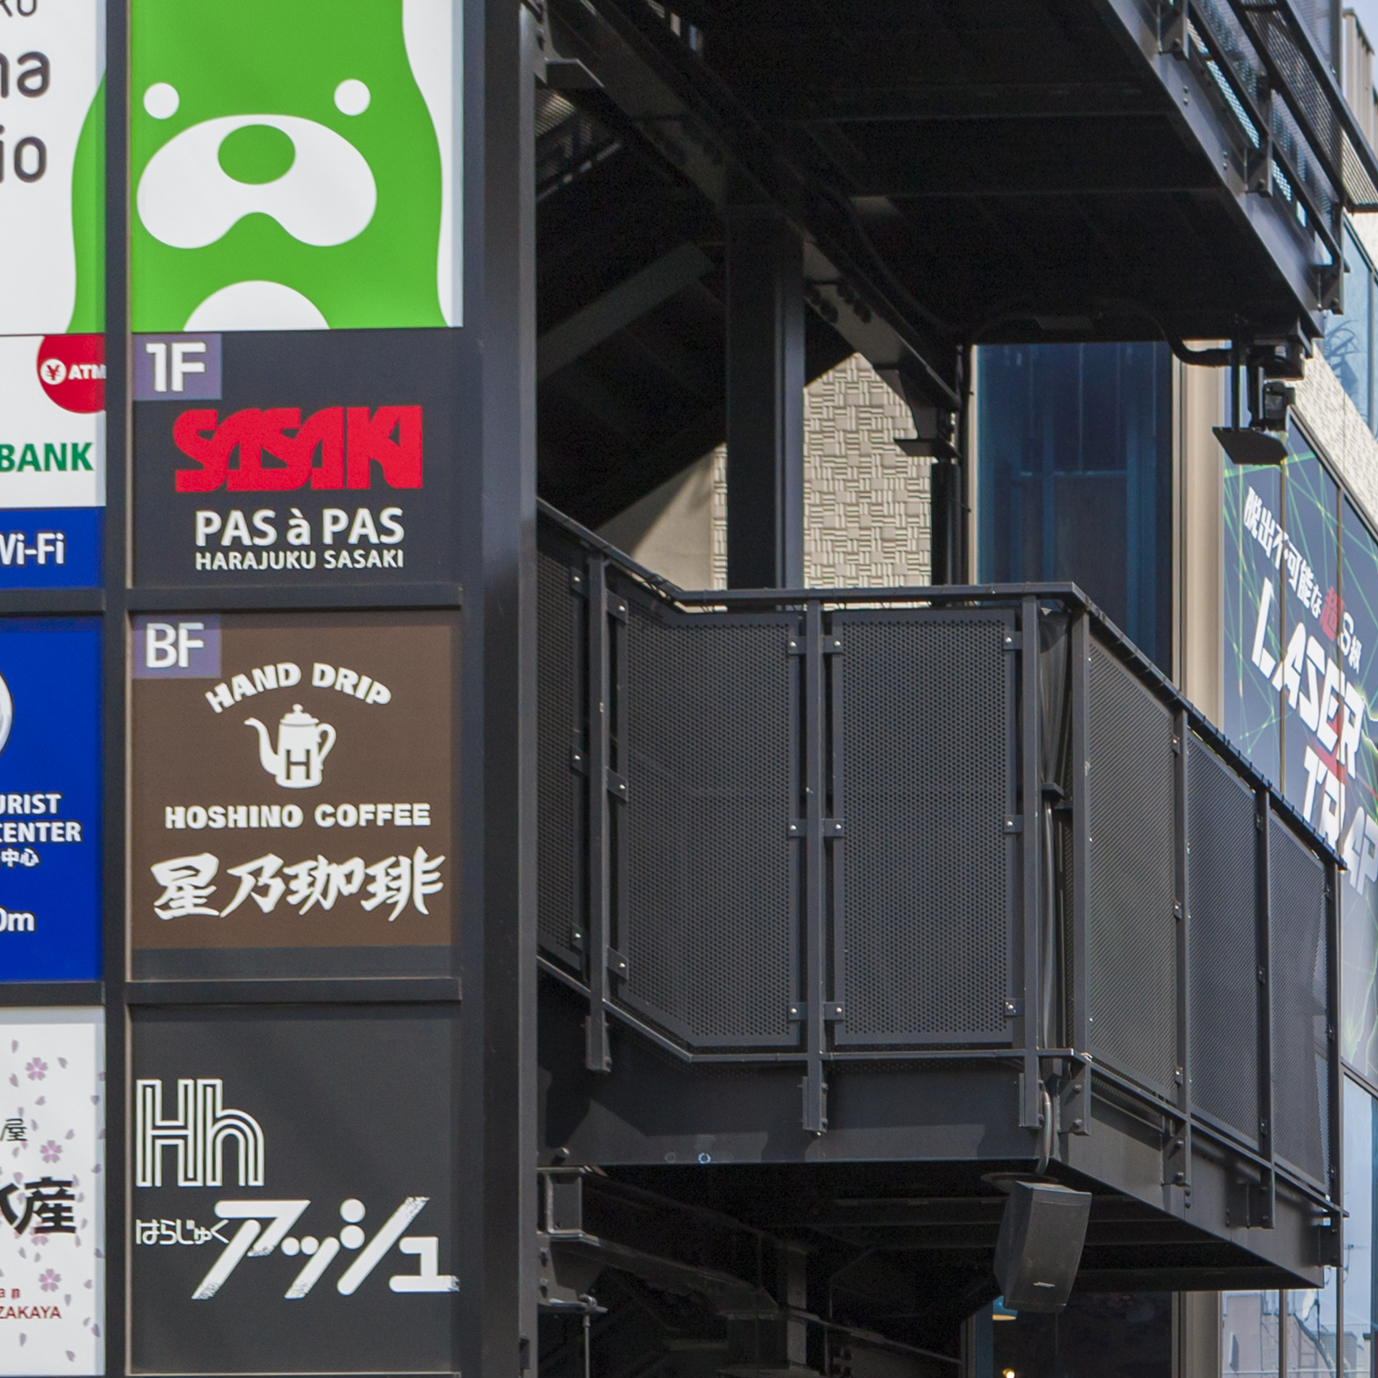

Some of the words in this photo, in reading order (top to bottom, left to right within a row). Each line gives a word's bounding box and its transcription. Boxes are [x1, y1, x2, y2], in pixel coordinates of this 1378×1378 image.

[146, 342, 206, 391] 1F
[173, 405, 423, 492] SASAKI
[195, 511, 277, 546] PAS
[288, 508, 311, 543] à
[322, 507, 405, 543] PAS
[195, 549, 317, 571] HARAJUKU
[324, 548, 404, 568] SASAKI
[146, 623, 205, 668] BF
[205, 662, 302, 714] HAND
[311, 662, 392, 705] DRIP
[1251, 576, 1367, 780] LASER
[0, 822, 82, 842] ENTER
[164, 805, 304, 829] HOSHINO
[314, 803, 431, 827] COFFEE
[150, 846, 446, 922] 星乃珈琲
[135, 1079, 264, 1187] Hh
